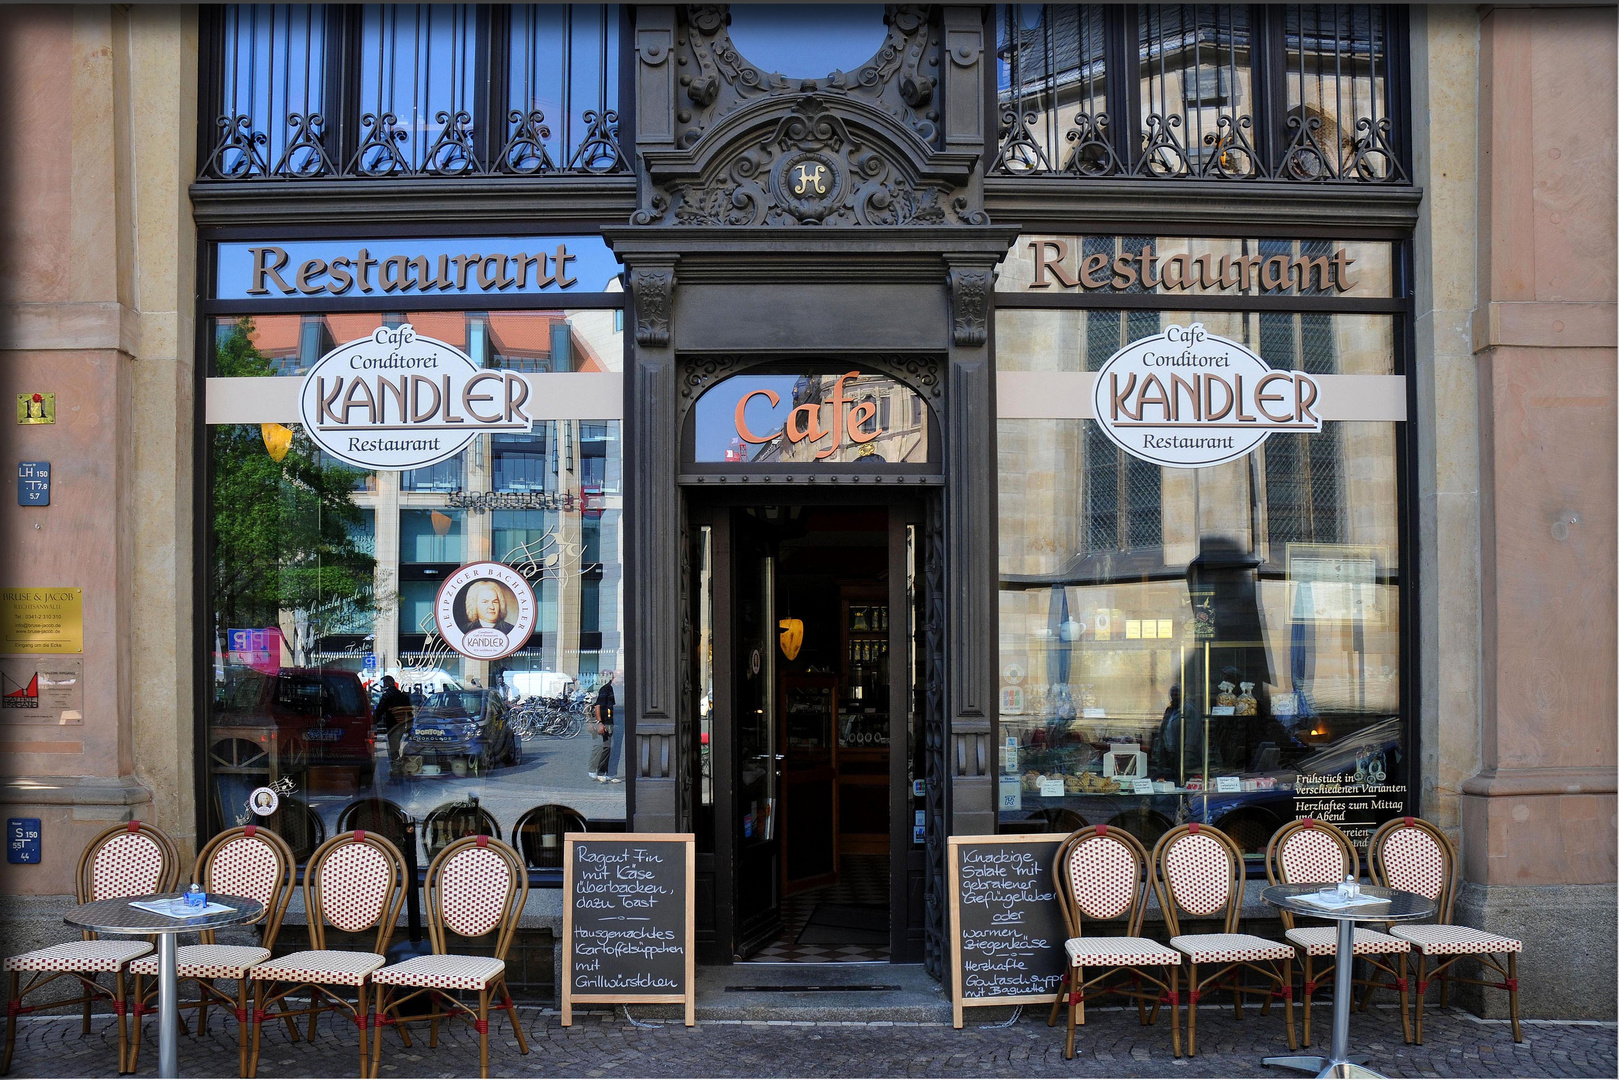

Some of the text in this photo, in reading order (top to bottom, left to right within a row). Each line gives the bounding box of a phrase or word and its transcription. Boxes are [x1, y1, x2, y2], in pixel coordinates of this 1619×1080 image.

[246, 244, 578, 295] Restaurant
[1028, 239, 1359, 292] Restaurant
[1167, 326, 1205, 348] Cafe
[350, 352, 439, 369] Conditorei
[1142, 351, 1230, 367] Conditorei
[316, 373, 529, 424] KANDLER
[1110, 372, 1318, 423] KANDLER
[23, 399, 48, 418] 11
[734, 370, 883, 458] Cafe
[348, 437, 441, 452] Restaurant
[1143, 434, 1235, 449] Restaurant
[19, 468, 33, 477] LH
[3, 592, 74, 603] BRUSE & JACOB
[442, 569, 480, 629] LEIPZIGER
[488, 568, 529, 630] BACHTALER
[467, 638, 504, 648] KANDLER
[1296, 773, 1355, 784] Frühstück in
[1296, 783, 1407, 795] verschiedenen Varianten
[1296, 800, 1346, 813] Herzhaftes
[1371, 800, 1403, 812] Mittag
[1316, 811, 1346, 821] Abend
[15, 828, 24, 838] S
[577, 846, 663, 870] Ragout Fin
[963, 849, 1034, 870] Knackige
[582, 863, 655, 880] mit Käse
[962, 861, 1043, 878] Salate mit
[963, 878, 1037, 895] gebratener
[576, 894, 659, 909] dazu Toast
[992, 910, 1025, 922] oder
[574, 925, 676, 945] Hausgemachtes
[964, 935, 1052, 955] Ziegenkäse
[575, 959, 601, 971] mit
[965, 957, 1029, 972] Herzhafte
[575, 972, 678, 988] Grillwürstchen
[965, 982, 1046, 998] mit Baguette
